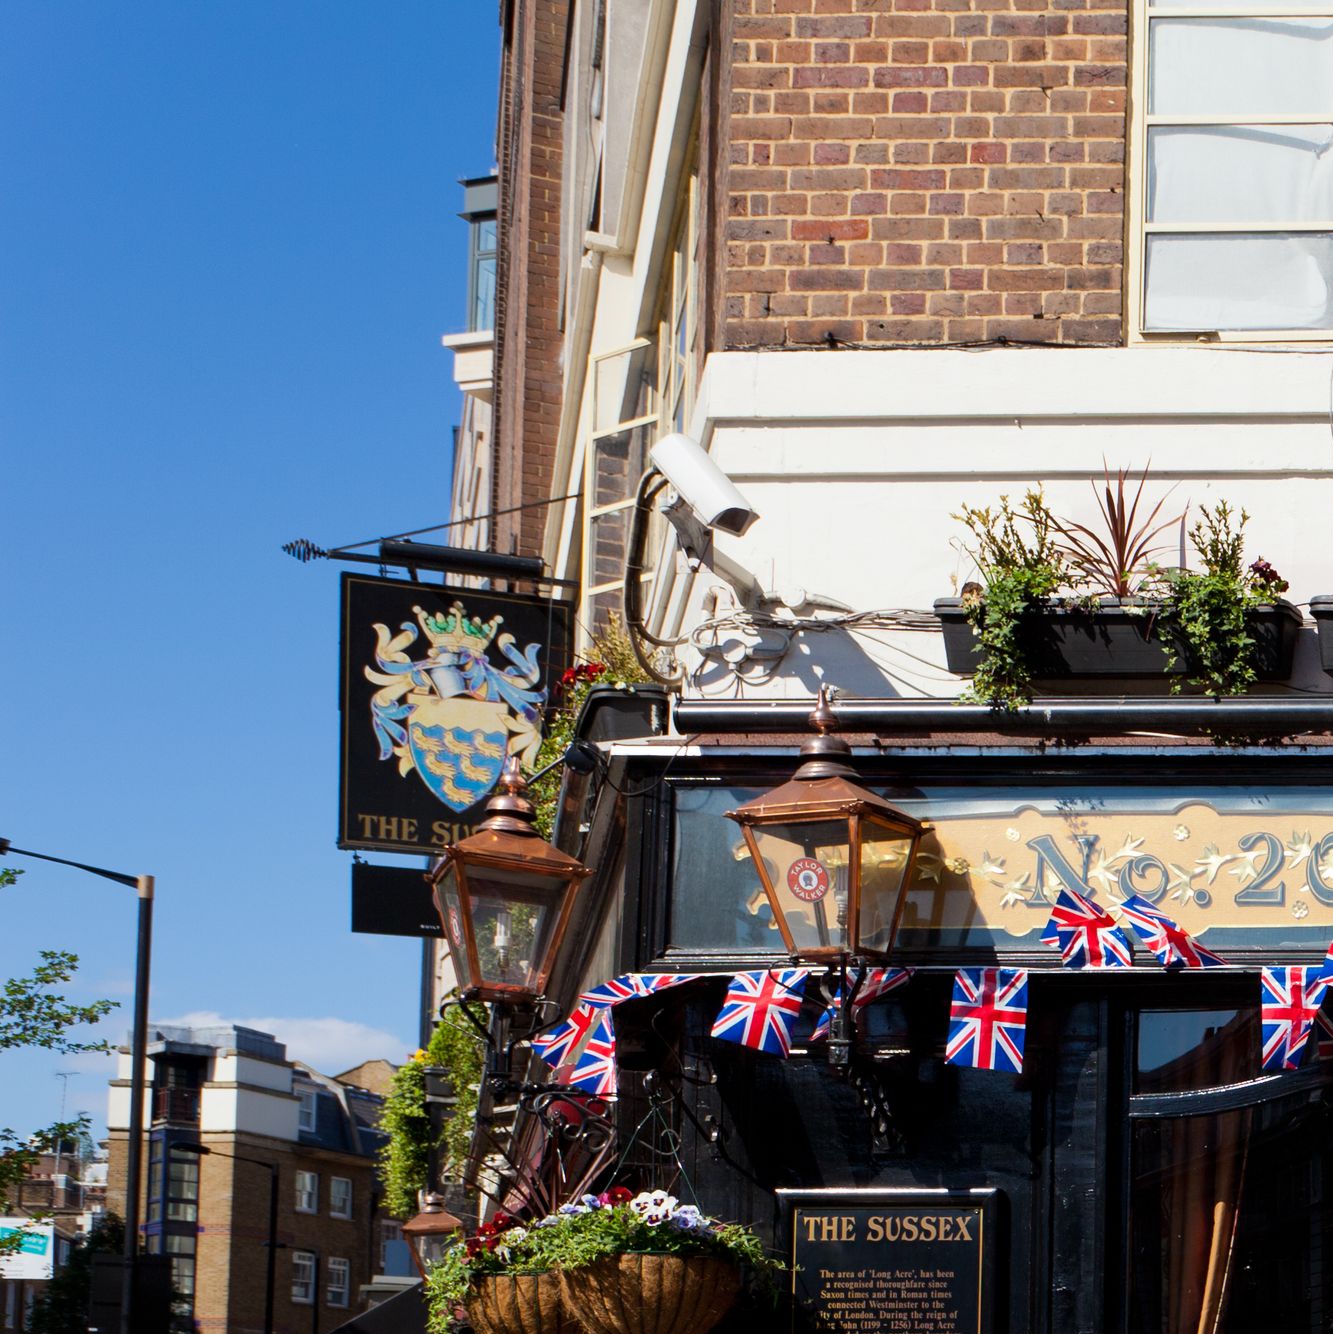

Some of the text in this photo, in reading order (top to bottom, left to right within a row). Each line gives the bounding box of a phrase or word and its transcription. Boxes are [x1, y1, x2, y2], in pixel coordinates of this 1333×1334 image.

[358, 814, 419, 842] THE
[791, 861, 826, 900] TAYLOR WALKER
[803, 1215, 973, 1242] THE SUSSEX
